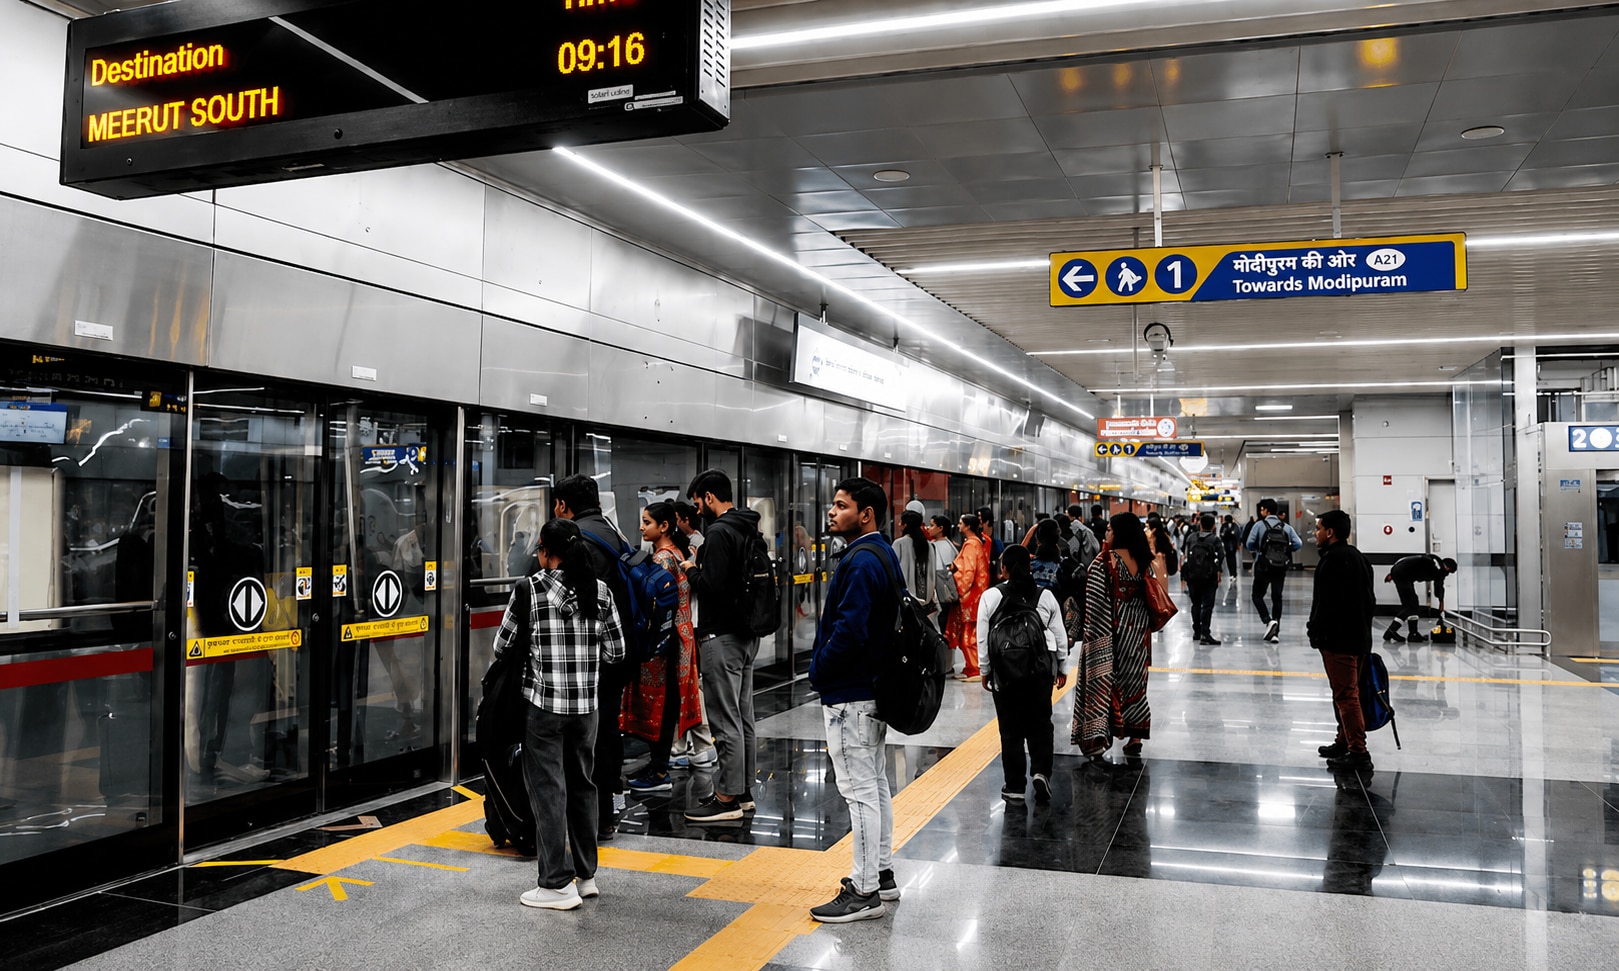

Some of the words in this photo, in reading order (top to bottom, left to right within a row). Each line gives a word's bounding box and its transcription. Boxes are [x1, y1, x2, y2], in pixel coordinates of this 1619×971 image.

[91, 43, 224, 87] Destination
[558, 31, 645, 74] 09:16
[88, 100, 185, 142] MEERUT
[190, 86, 280, 127] SOUTH
[1166, 260, 1182, 289] 1
[1233, 253, 1298, 277] मोदीपुरम
[1301, 250, 1324, 270] की
[1327, 249, 1357, 268] ओर
[1373, 254, 1398, 266] A21
[1233, 276, 1303, 293] Towards
[1308, 273, 1407, 292] Modipuram
[1572, 428, 1587, 449] 2
